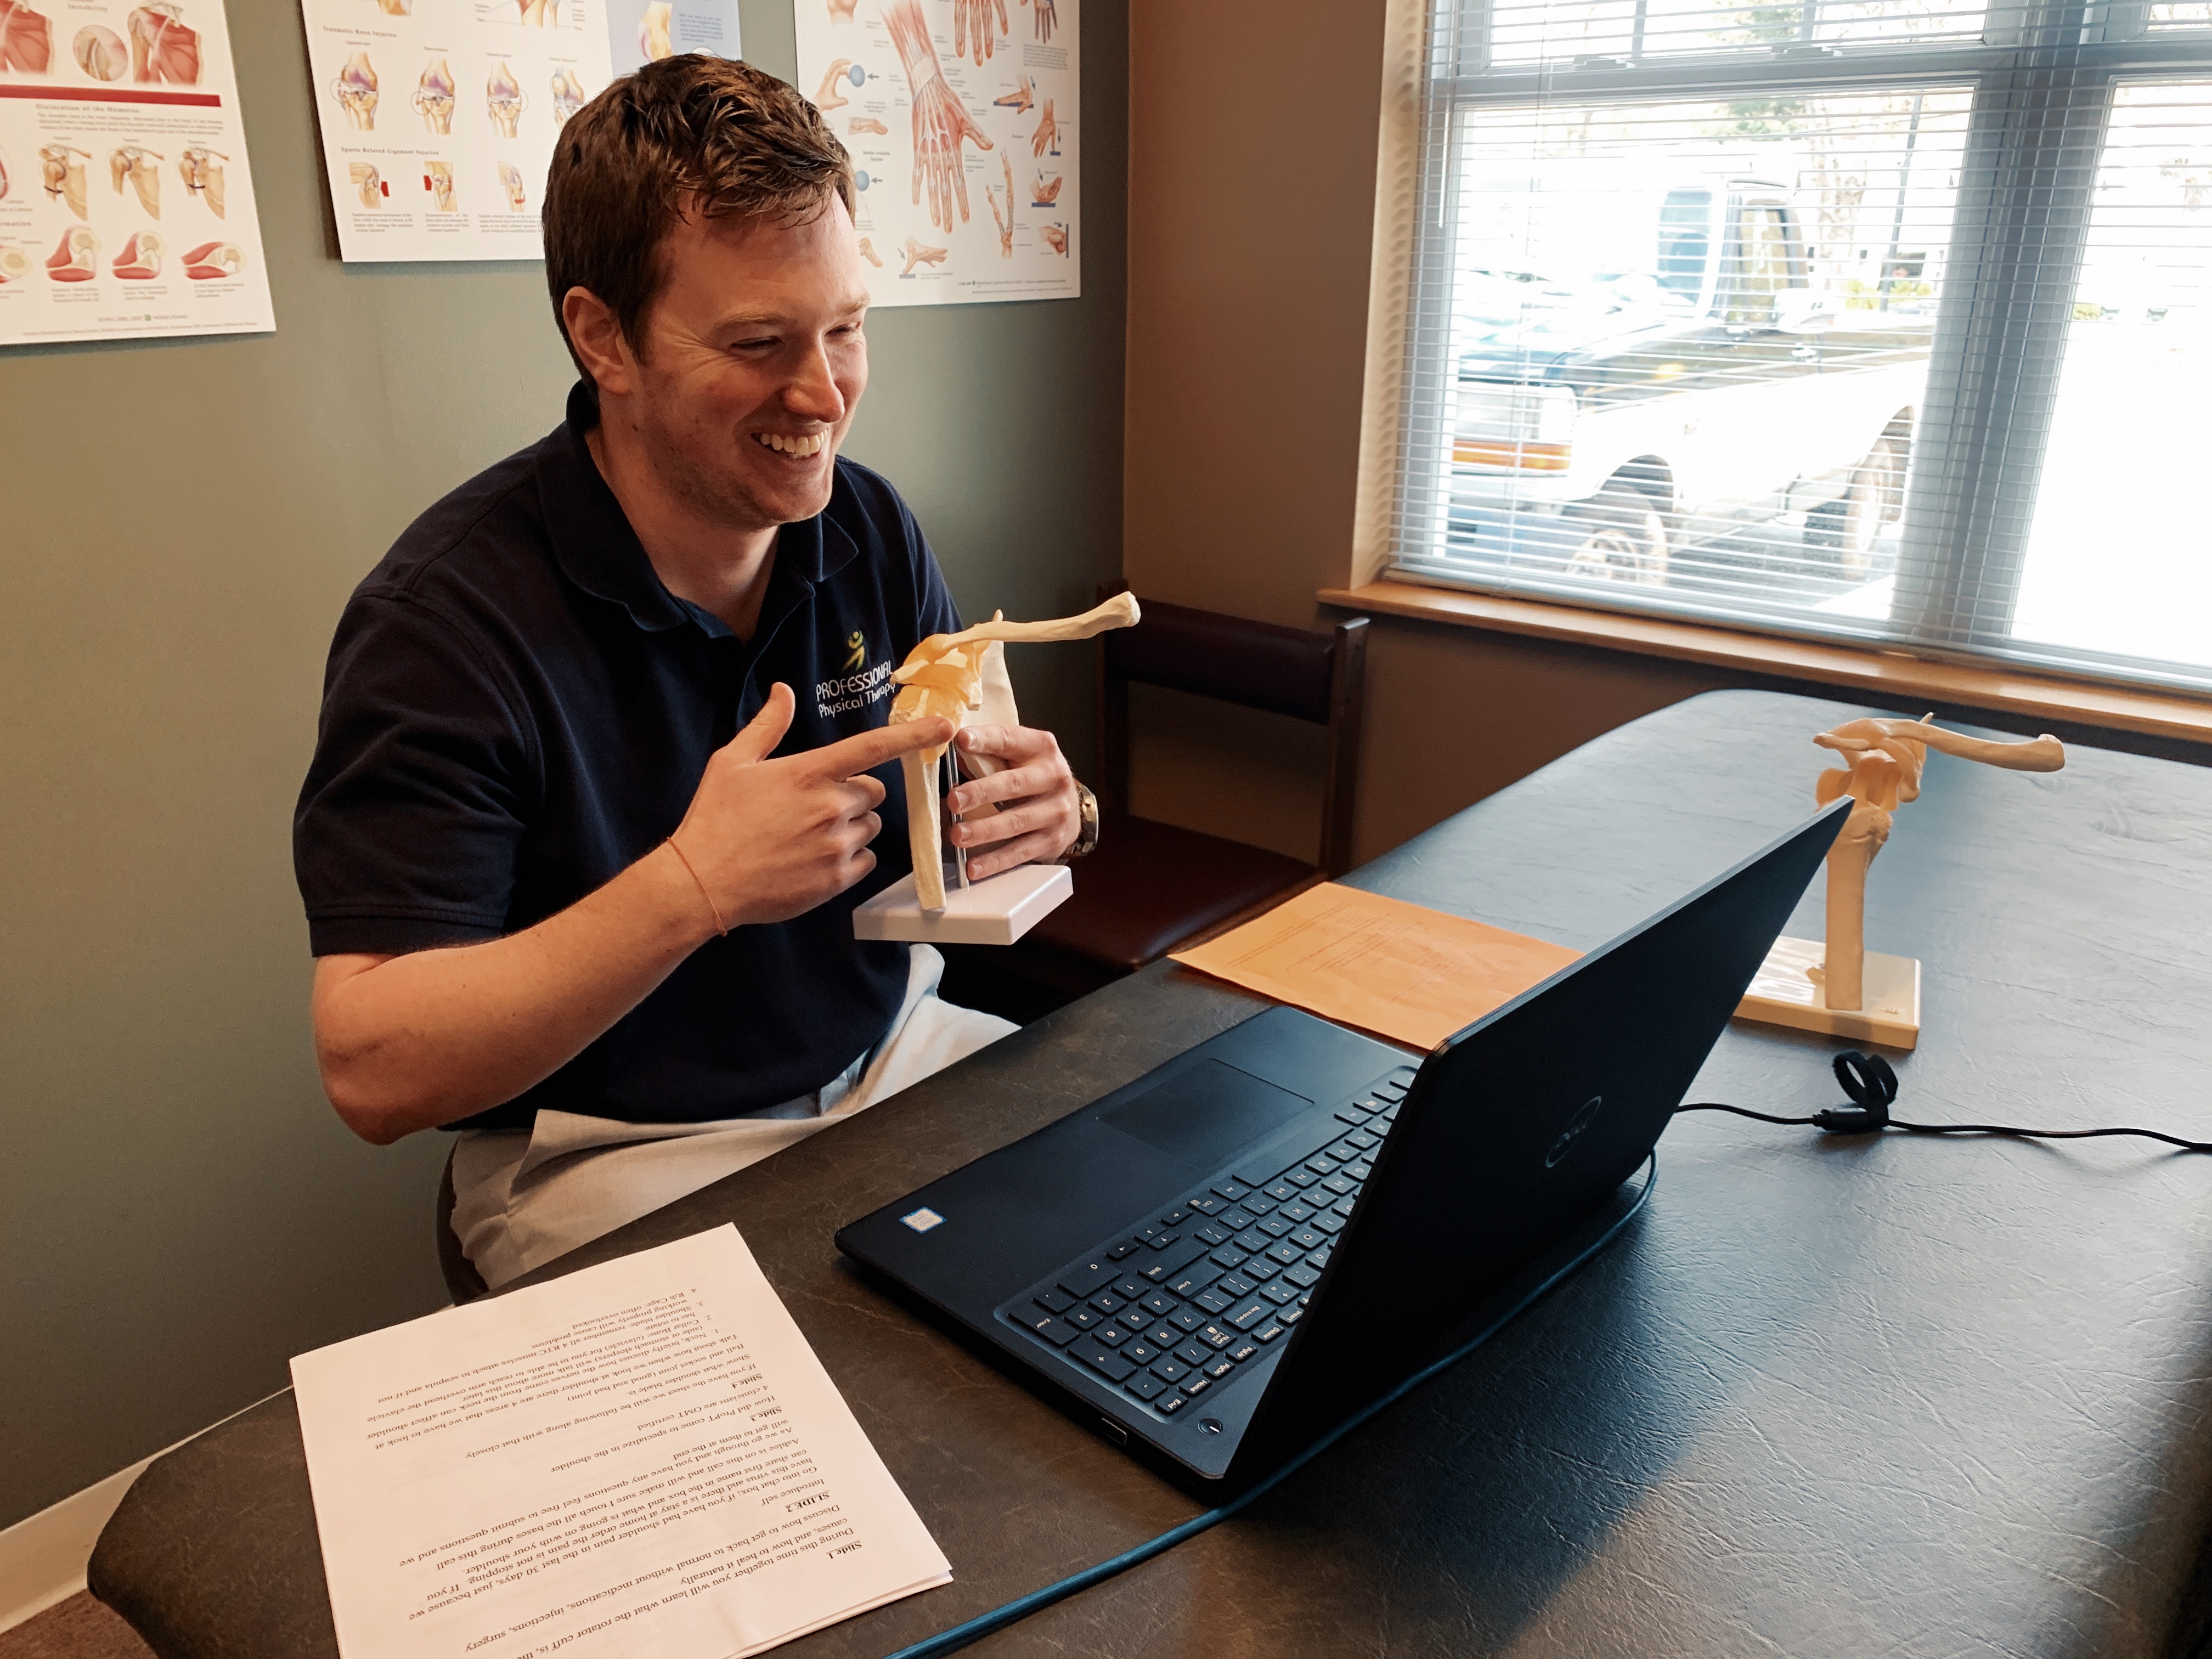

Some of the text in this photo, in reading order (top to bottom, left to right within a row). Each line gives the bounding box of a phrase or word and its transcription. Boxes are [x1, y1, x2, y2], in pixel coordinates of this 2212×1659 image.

[816, 660, 893, 702] PROFESSIONAL
[819, 682, 895, 718] Physical Therapy
[1036, 1318, 1050, 1328] Enter
[1237, 1346, 1252, 1357] PgUp
[726, 1353, 749, 1365] Show
[567, 1344, 744, 1401] Ball and socket joint (good and bad joint)
[703, 1363, 724, 1372] what
[664, 1370, 701, 1384] shoulder
[738, 1374, 762, 1385] Slide
[638, 1382, 663, 1392] blade
[1190, 1380, 1207, 1391] Home
[719, 1387, 760, 1404] clinicians
[754, 1395, 775, 1406] How
[737, 1404, 751, 1413] did
[1168, 1399, 1181, 1409] End
[678, 1407, 702, 1418] OMT
[708, 1409, 735, 1421] ProPT
[757, 1407, 782, 1418] Slide
[637, 1414, 674, 1431] certified
[680, 1418, 705, 1429] come
[622, 1430, 667, 1448] specialize
[769, 1438, 798, 1451] Ashlee
[551, 1455, 591, 1472] shoulder
[725, 1456, 743, 1464] this
[707, 1462, 723, 1472] call
[687, 1468, 704, 1479] and
[782, 1471, 801, 1480] into
[667, 1475, 686, 1486] will
[760, 1478, 780, 1488] chat
[639, 1482, 664, 1495] make
[737, 1485, 759, 1496] box;
[761, 1479, 825, 1506] Introduce self
[616, 1492, 636, 1503] sure
[707, 1496, 726, 1506] you
[727, 1493, 736, 1502] if
[794, 1492, 830, 1509] SLIDE
[579, 1503, 607, 1516] touch
[682, 1504, 706, 1516] have
[803, 1504, 840, 1521] Discuss
[546, 1519, 562, 1527] the
[564, 1513, 577, 1522] all
[662, 1513, 681, 1525] had
[618, 1521, 659, 1539] shoulder
[781, 1518, 802, 1530] how
[813, 1518, 847, 1533] causes,
[516, 1525, 544, 1538] bases
[751, 1530, 766, 1542] get
[794, 1531, 811, 1543] and
[819, 1527, 854, 1544] During
[479, 1536, 513, 1552] during
[593, 1534, 615, 1548] pain
[725, 1538, 750, 1551] back
[772, 1538, 793, 1551] how
[799, 1541, 818, 1551] this
[834, 1541, 862, 1554] Slide
[458, 1549, 477, 1560] this
[562, 1550, 578, 1559] the
[736, 1553, 758, 1566] heal
[775, 1549, 798, 1561] time
[436, 1558, 455, 1570] call
[541, 1557, 560, 1568] last
[675, 1552, 712, 1570] normal
[526, 1565, 539, 1575] 30
[734, 1558, 774, 1577] together
[495, 1572, 523, 1584] days,
[634, 1566, 674, 1584] without
[680, 1565, 724, 1585] naturally
[712, 1573, 731, 1585] you
[473, 1581, 493, 1594] just
[690, 1583, 710, 1595] will
[566, 1581, 633, 1609] medications,
[661, 1590, 688, 1604] learn
[428, 1591, 471, 1612] because
[633, 1601, 659, 1615] what
[409, 1610, 425, 1620] we
[508, 1607, 564, 1632] injections,
[614, 1611, 631, 1621] the
[577, 1618, 612, 1638] rotator
[465, 1630, 506, 1652] surgery
[551, 1635, 573, 1651] cuff
[535, 1645, 549, 1653] is,
